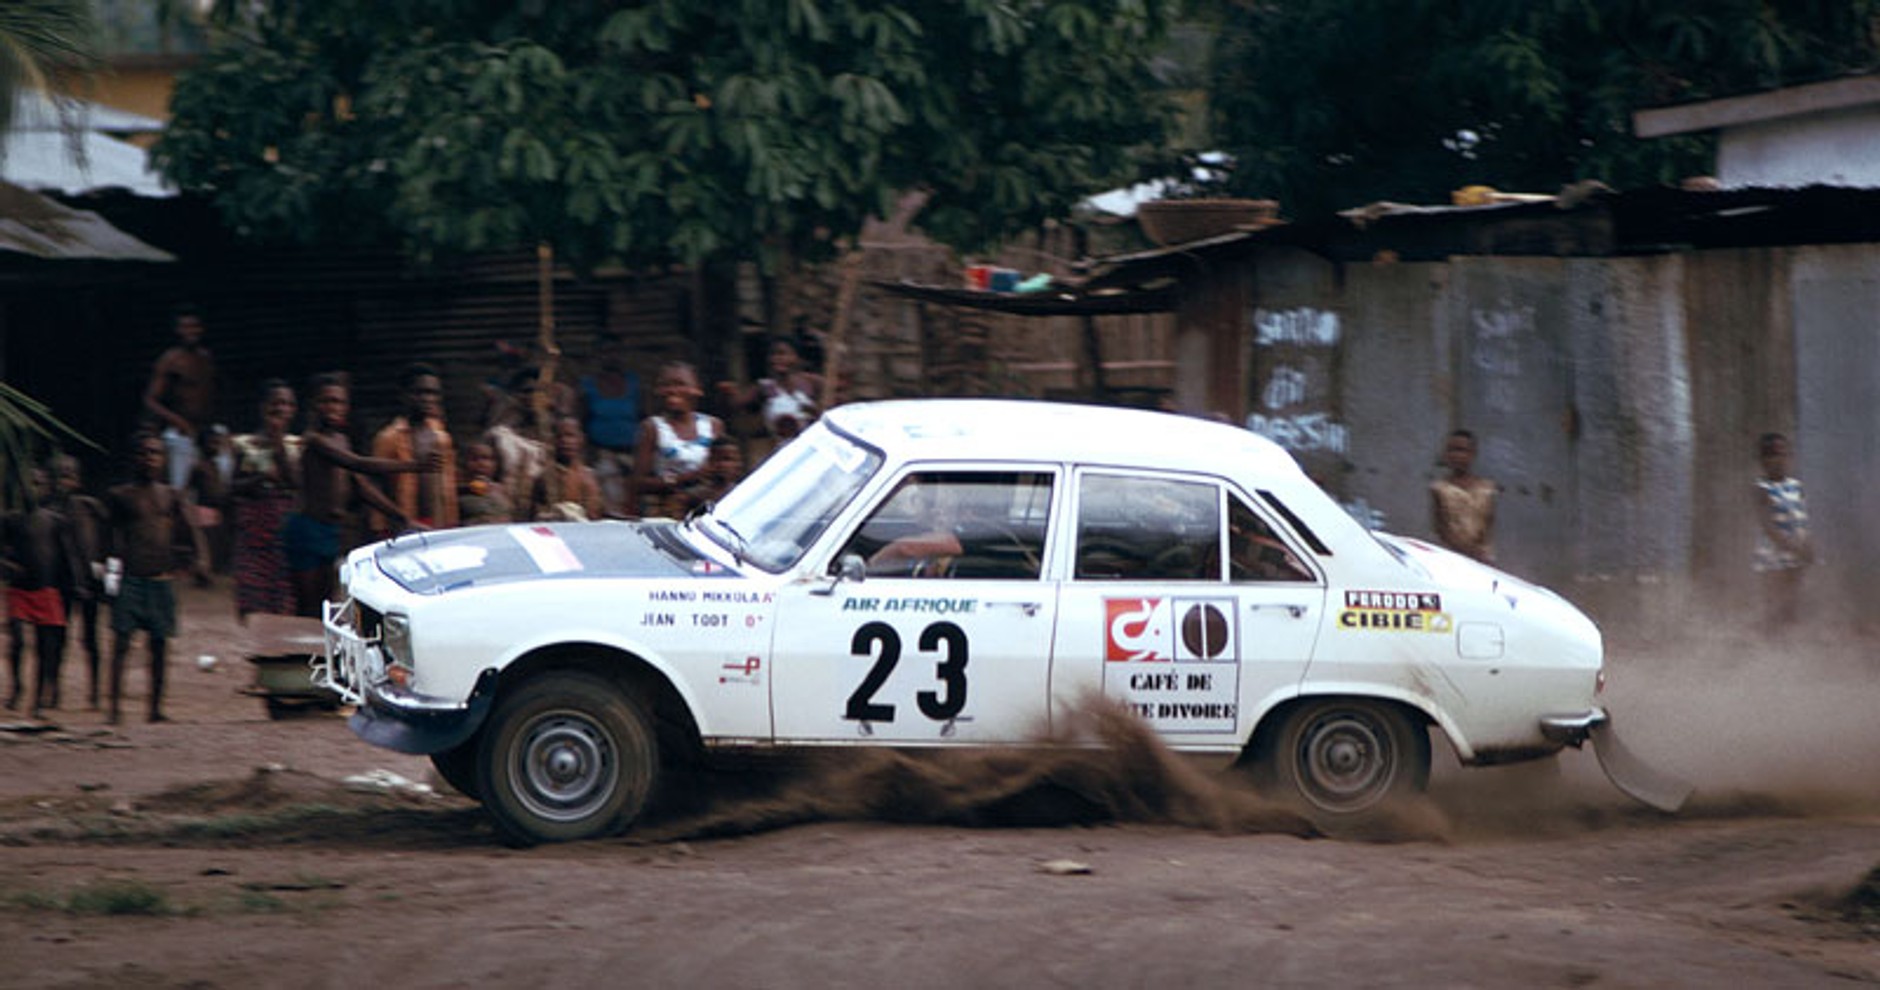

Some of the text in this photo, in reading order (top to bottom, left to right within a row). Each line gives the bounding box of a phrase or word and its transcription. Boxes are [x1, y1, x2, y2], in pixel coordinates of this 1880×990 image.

[842, 597, 978, 614] AIR AFRIQUE
[1348, 592, 1418, 608] FERODO
[640, 612, 675, 627] JEAN
[846, 620, 969, 723] 23
[1130, 668, 1212, 691] CAFÉ DE
